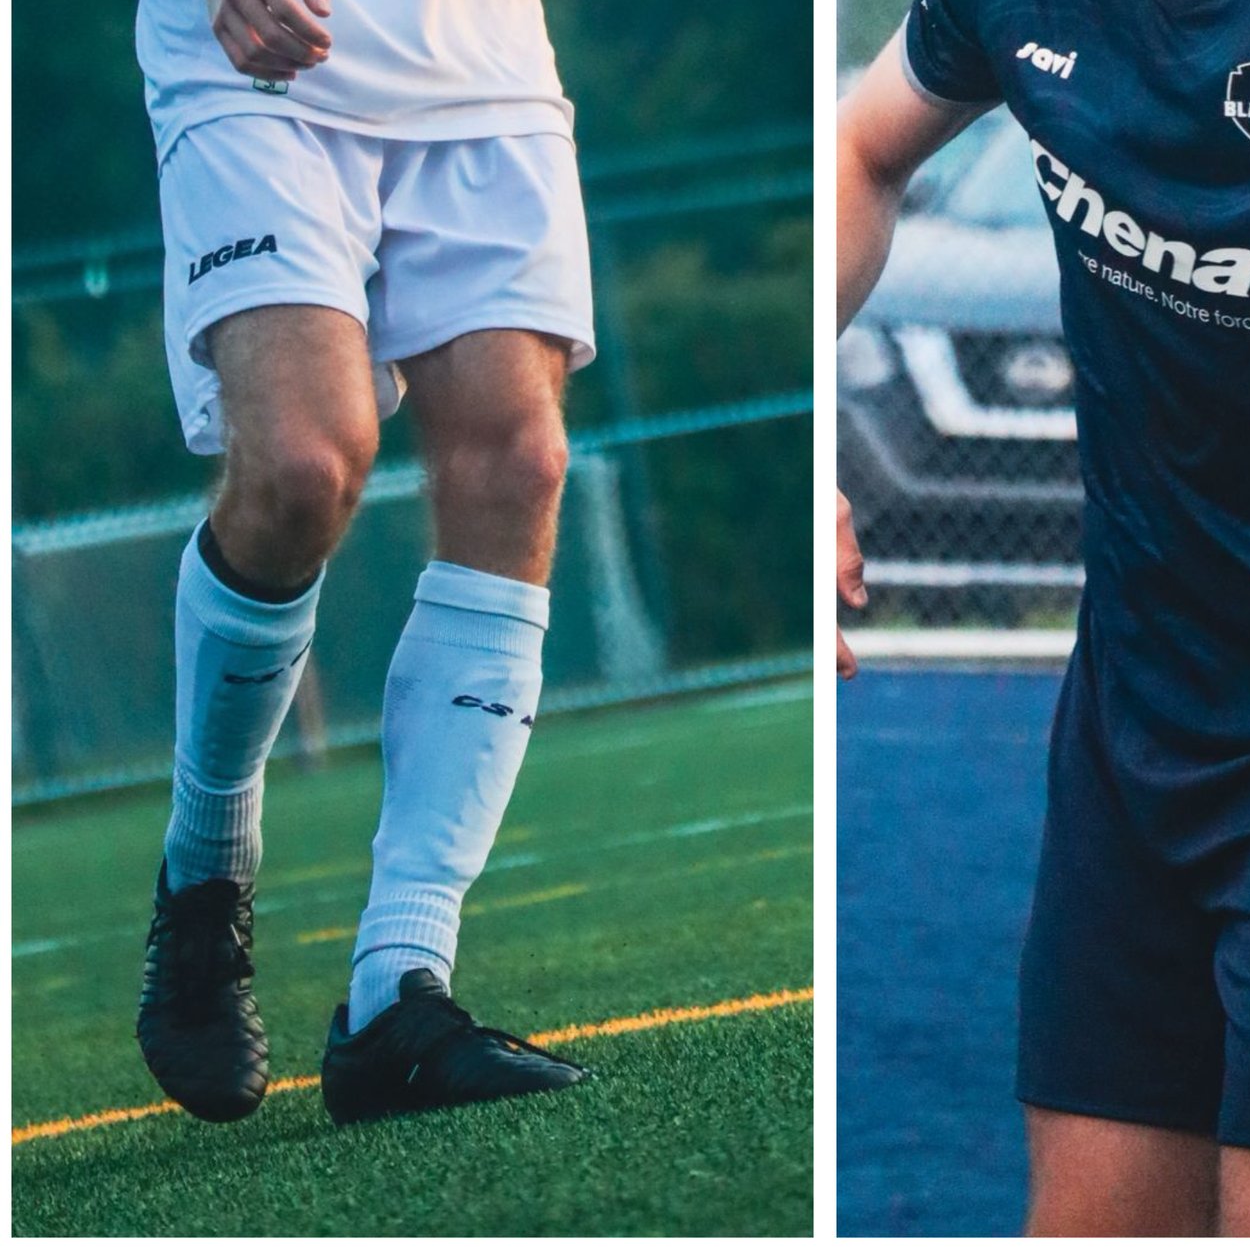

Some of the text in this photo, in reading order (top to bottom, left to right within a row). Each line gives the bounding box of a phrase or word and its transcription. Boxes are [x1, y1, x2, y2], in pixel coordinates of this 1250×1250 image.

[1015, 42, 1078, 79] savi
[188, 234, 278, 285] LEGEA
[1102, 264, 1159, 302] nature.
[1161, 291, 1210, 323] Notre
